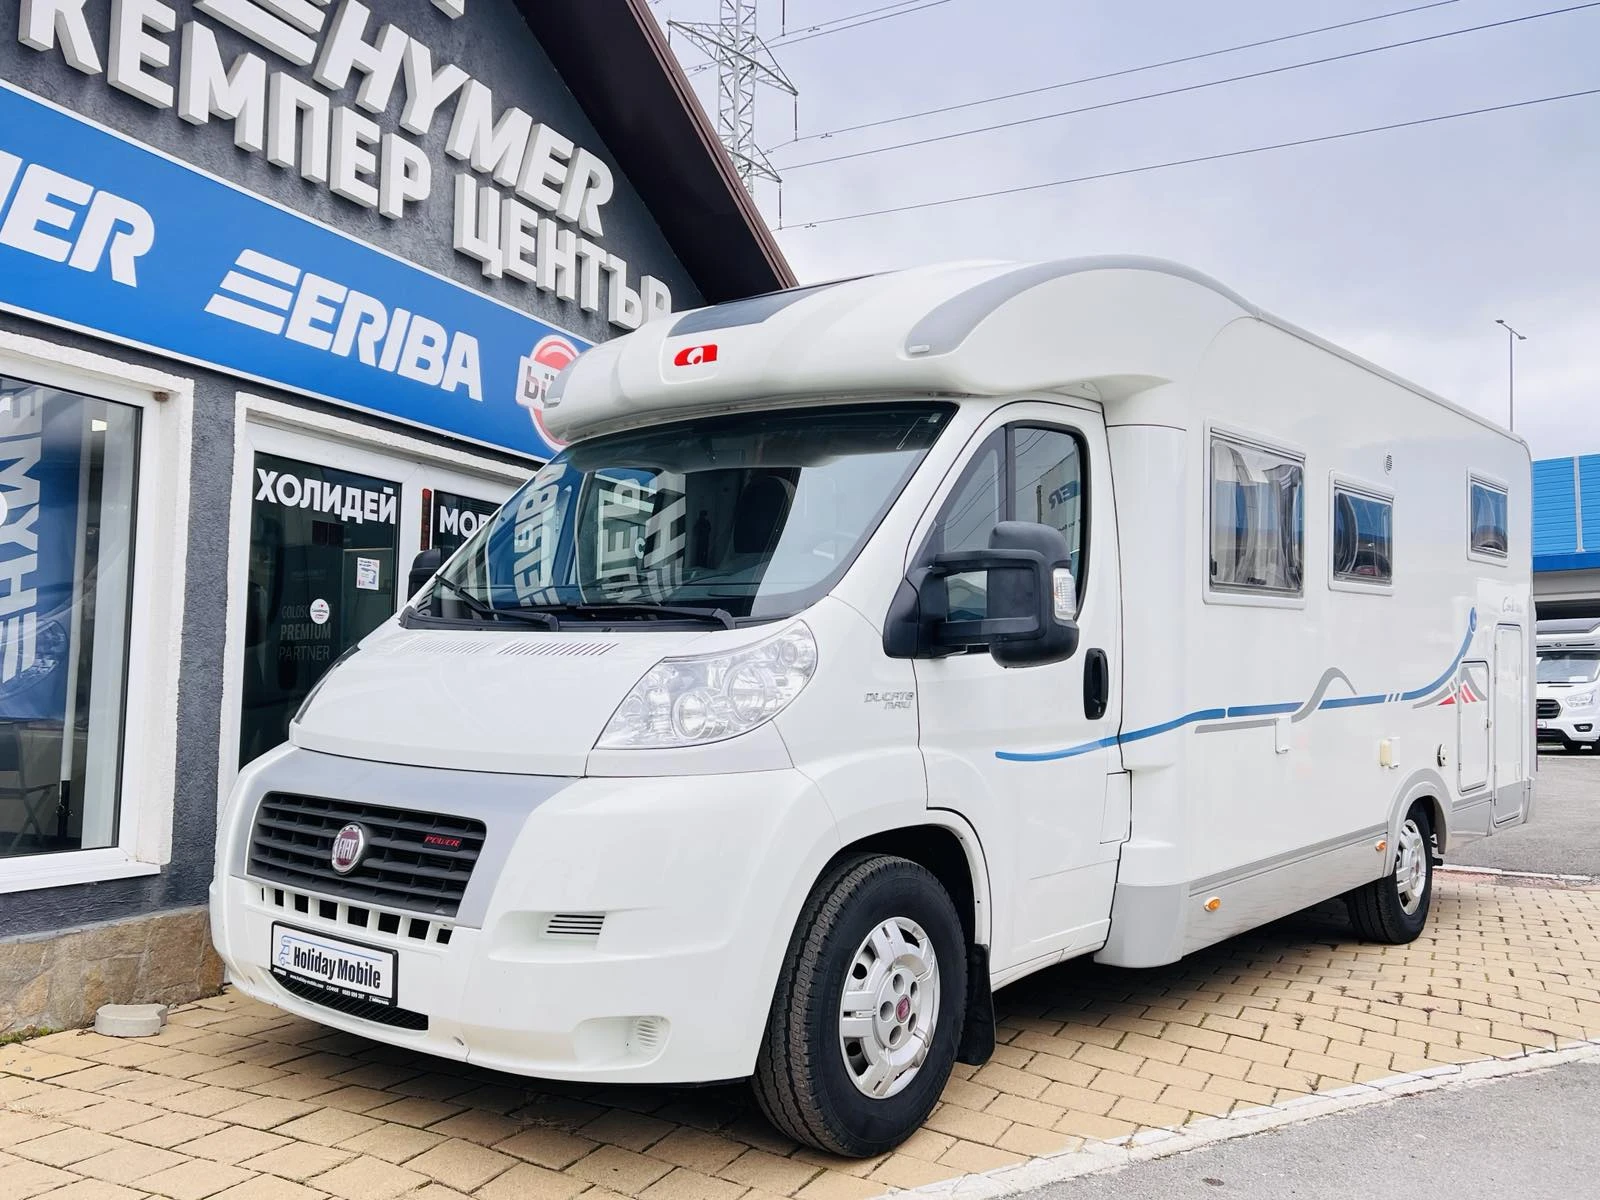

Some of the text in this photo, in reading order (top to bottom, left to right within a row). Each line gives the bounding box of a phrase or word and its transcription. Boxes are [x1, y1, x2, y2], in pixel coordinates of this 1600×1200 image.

[313, 0, 613, 237] HYMER
[18, 0, 672, 329] КЕМПЕР ЦЕНТЪР
[285, 272, 483, 402] ERIBA
[255, 467, 397, 525] ХОЛИДЕЙ
[279, 645, 330, 661] PARTNER
[280, 623, 332, 641] PREMIUM
[336, 838, 358, 860] FIAT
[293, 946, 381, 989] Holiday Mobile
